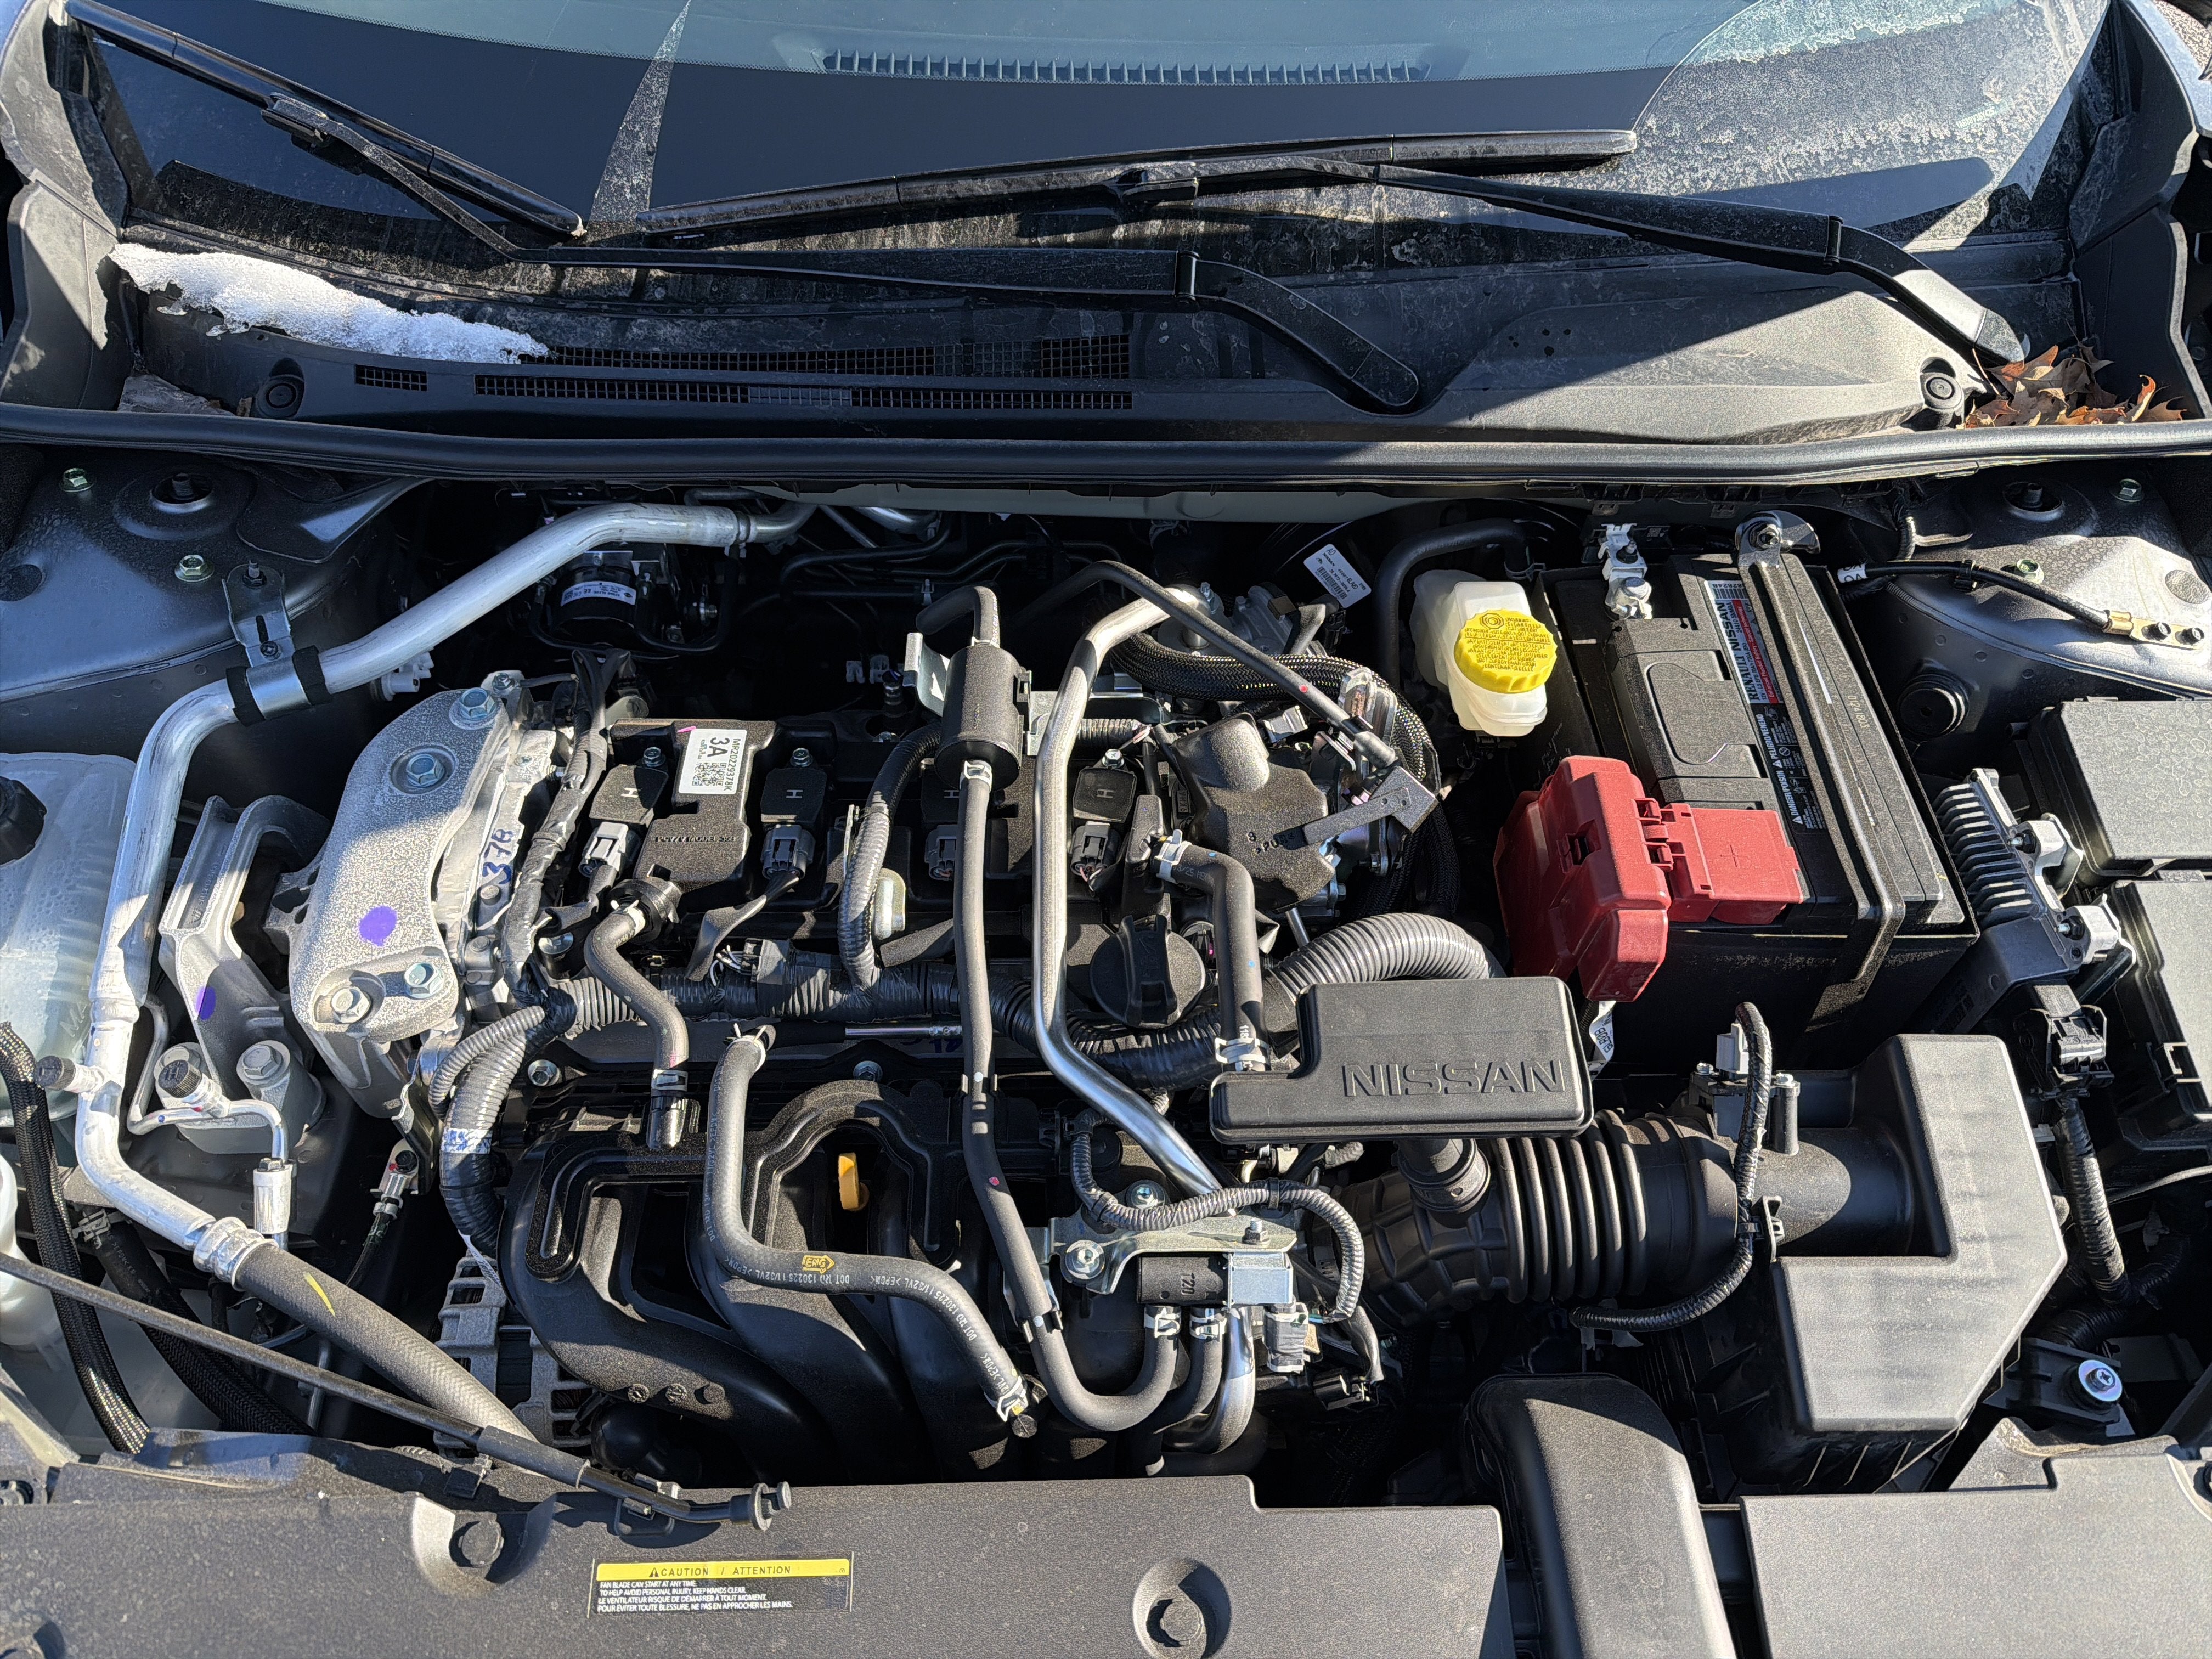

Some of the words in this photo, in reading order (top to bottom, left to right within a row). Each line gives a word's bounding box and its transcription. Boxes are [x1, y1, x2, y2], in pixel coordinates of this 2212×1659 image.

[1716, 602, 1741, 651] NISSAN
[1735, 656, 1760, 701] RENAULT
[1848, 695, 1867, 729] 01241803
[707, 737, 730, 757] 3A
[1756, 714, 1778, 759] PELIGRO/VENENO
[723, 738, 741, 790] MR20229378K
[1776, 770, 1799, 816] DANGER/POISON
[1342, 1059, 1565, 1096] NISSAN
[807, 1257, 826, 1269] ENG
[788, 1273, 816, 1284] 130225
[835, 1274, 849, 1284] DOT
[934, 1290, 959, 1314] 130225
[963, 1325, 976, 1340] DOT
[661, 1567, 708, 1576] CAUTION
[733, 1566, 790, 1575] ATTENTION
[616, 1604, 637, 1612] ÉVITER
